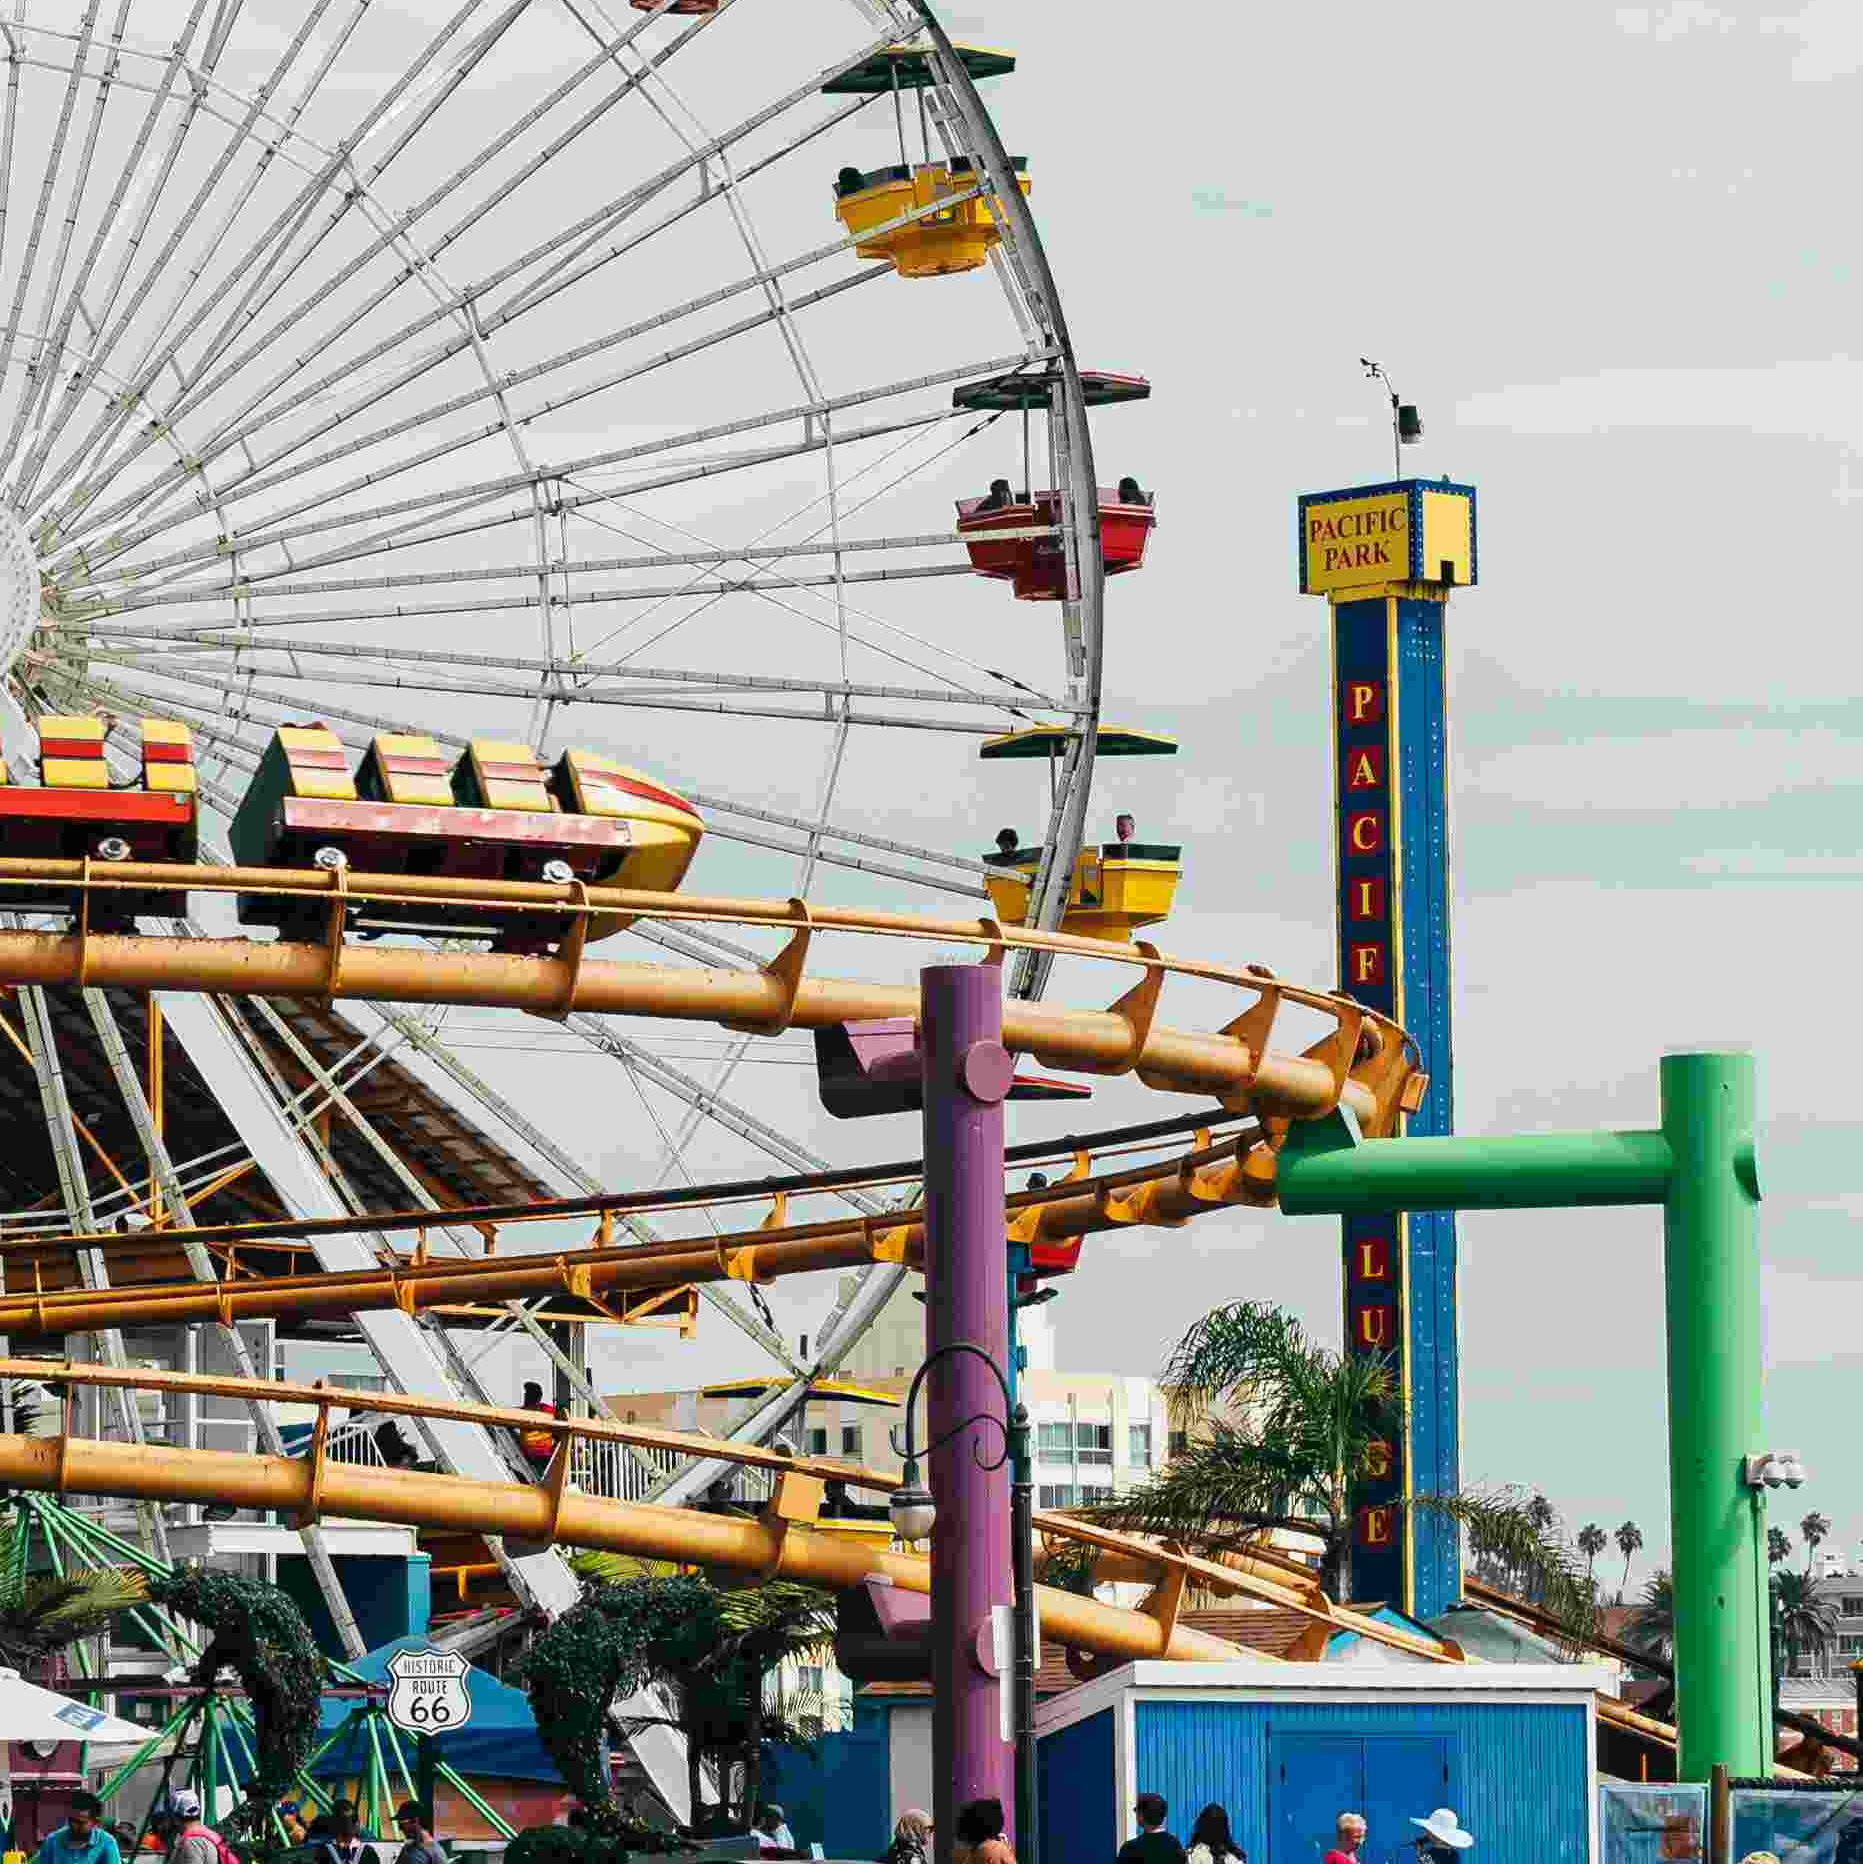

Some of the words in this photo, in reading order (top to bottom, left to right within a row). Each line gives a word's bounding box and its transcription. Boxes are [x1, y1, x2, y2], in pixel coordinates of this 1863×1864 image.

[1310, 507, 1406, 542] PACIFIC
[1324, 540, 1391, 571] PARK
[402, 1658, 456, 1674] HISTORIC
[412, 1680, 448, 1694] ROUTE
[410, 1696, 450, 1723] 66
